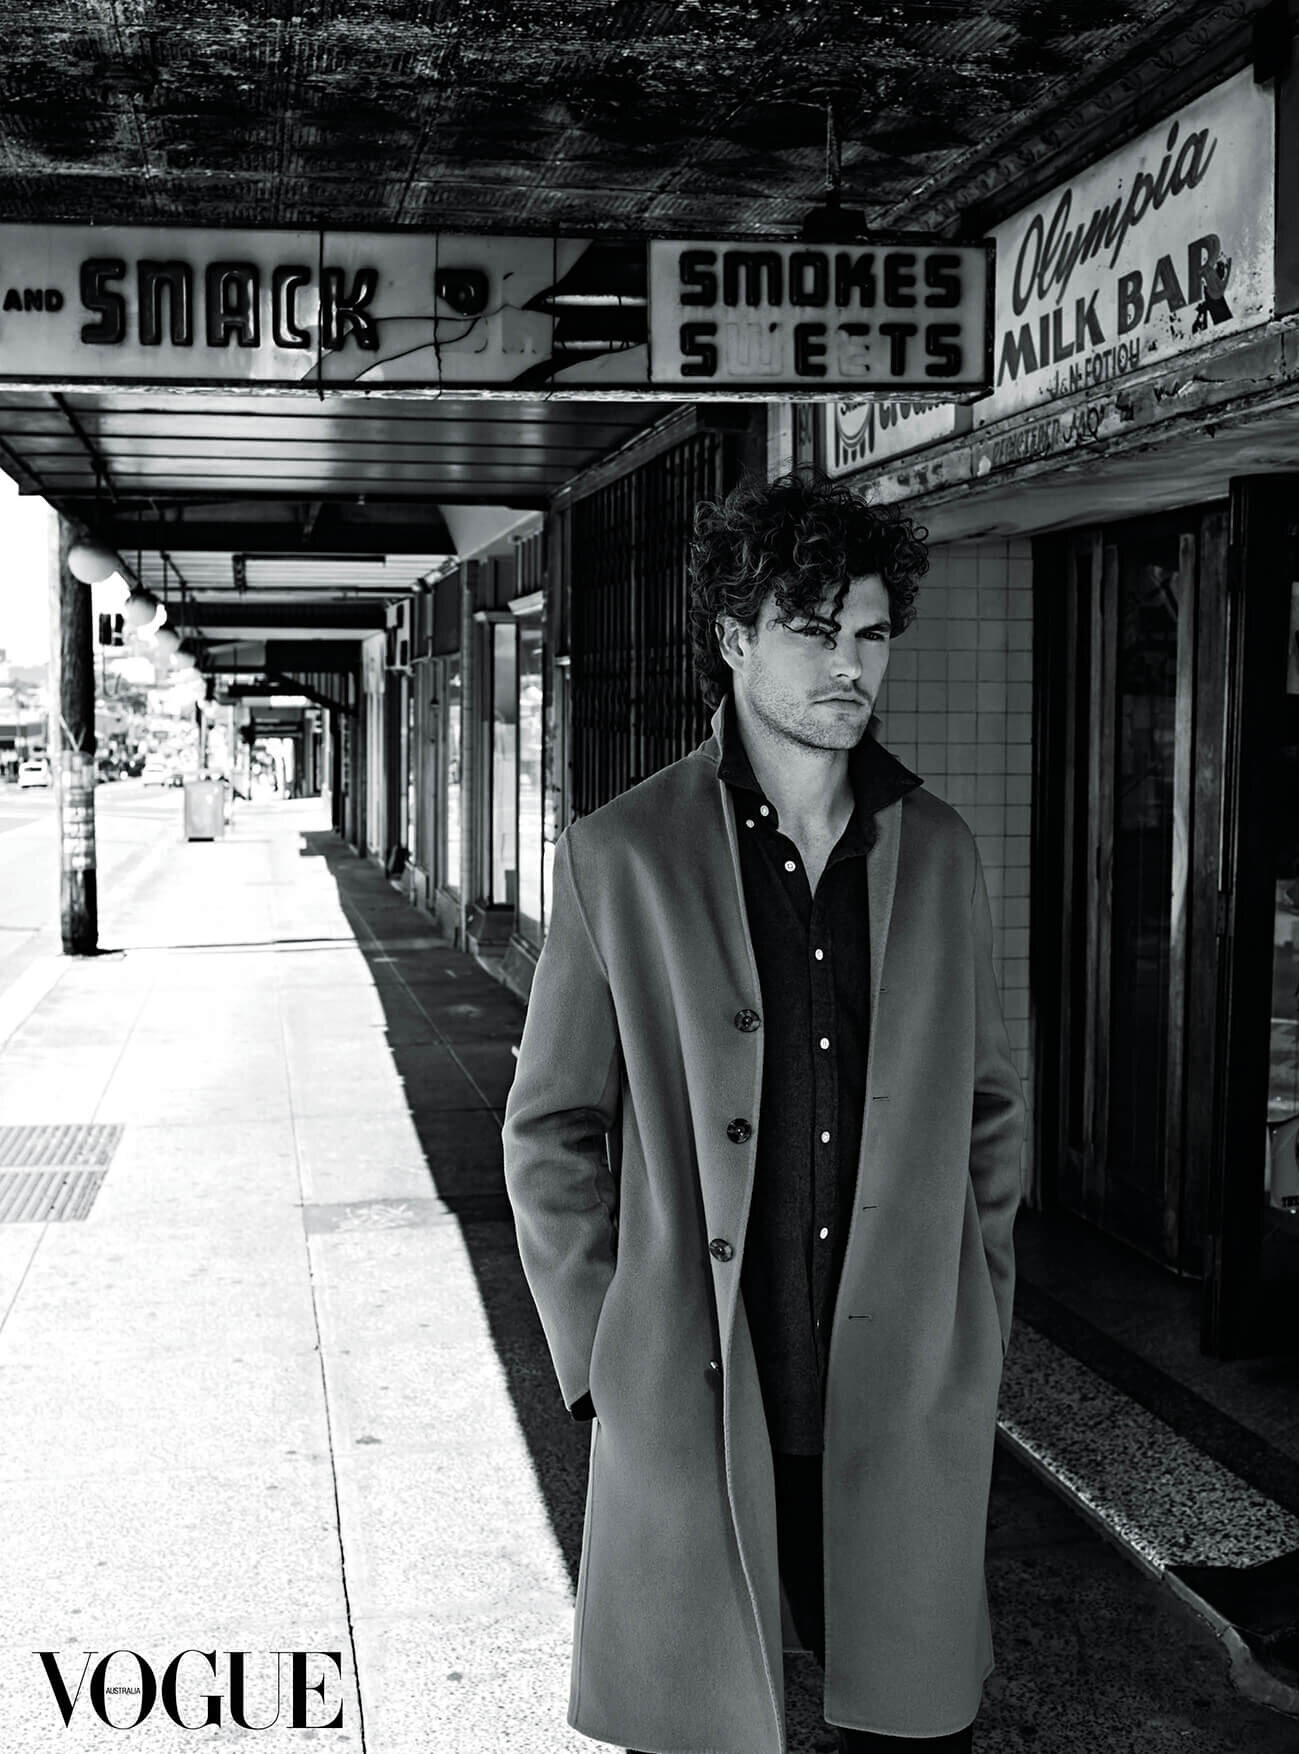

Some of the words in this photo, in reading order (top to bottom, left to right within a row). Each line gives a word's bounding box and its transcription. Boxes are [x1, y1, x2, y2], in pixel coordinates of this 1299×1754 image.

[679, 250, 962, 309] SMOKES
[1013, 120, 1218, 316] Olympia
[2, 288, 64, 312] AND
[80, 257, 380, 351] SNACK
[998, 288, 1106, 388] MILK
[1117, 233, 1233, 336] BAR
